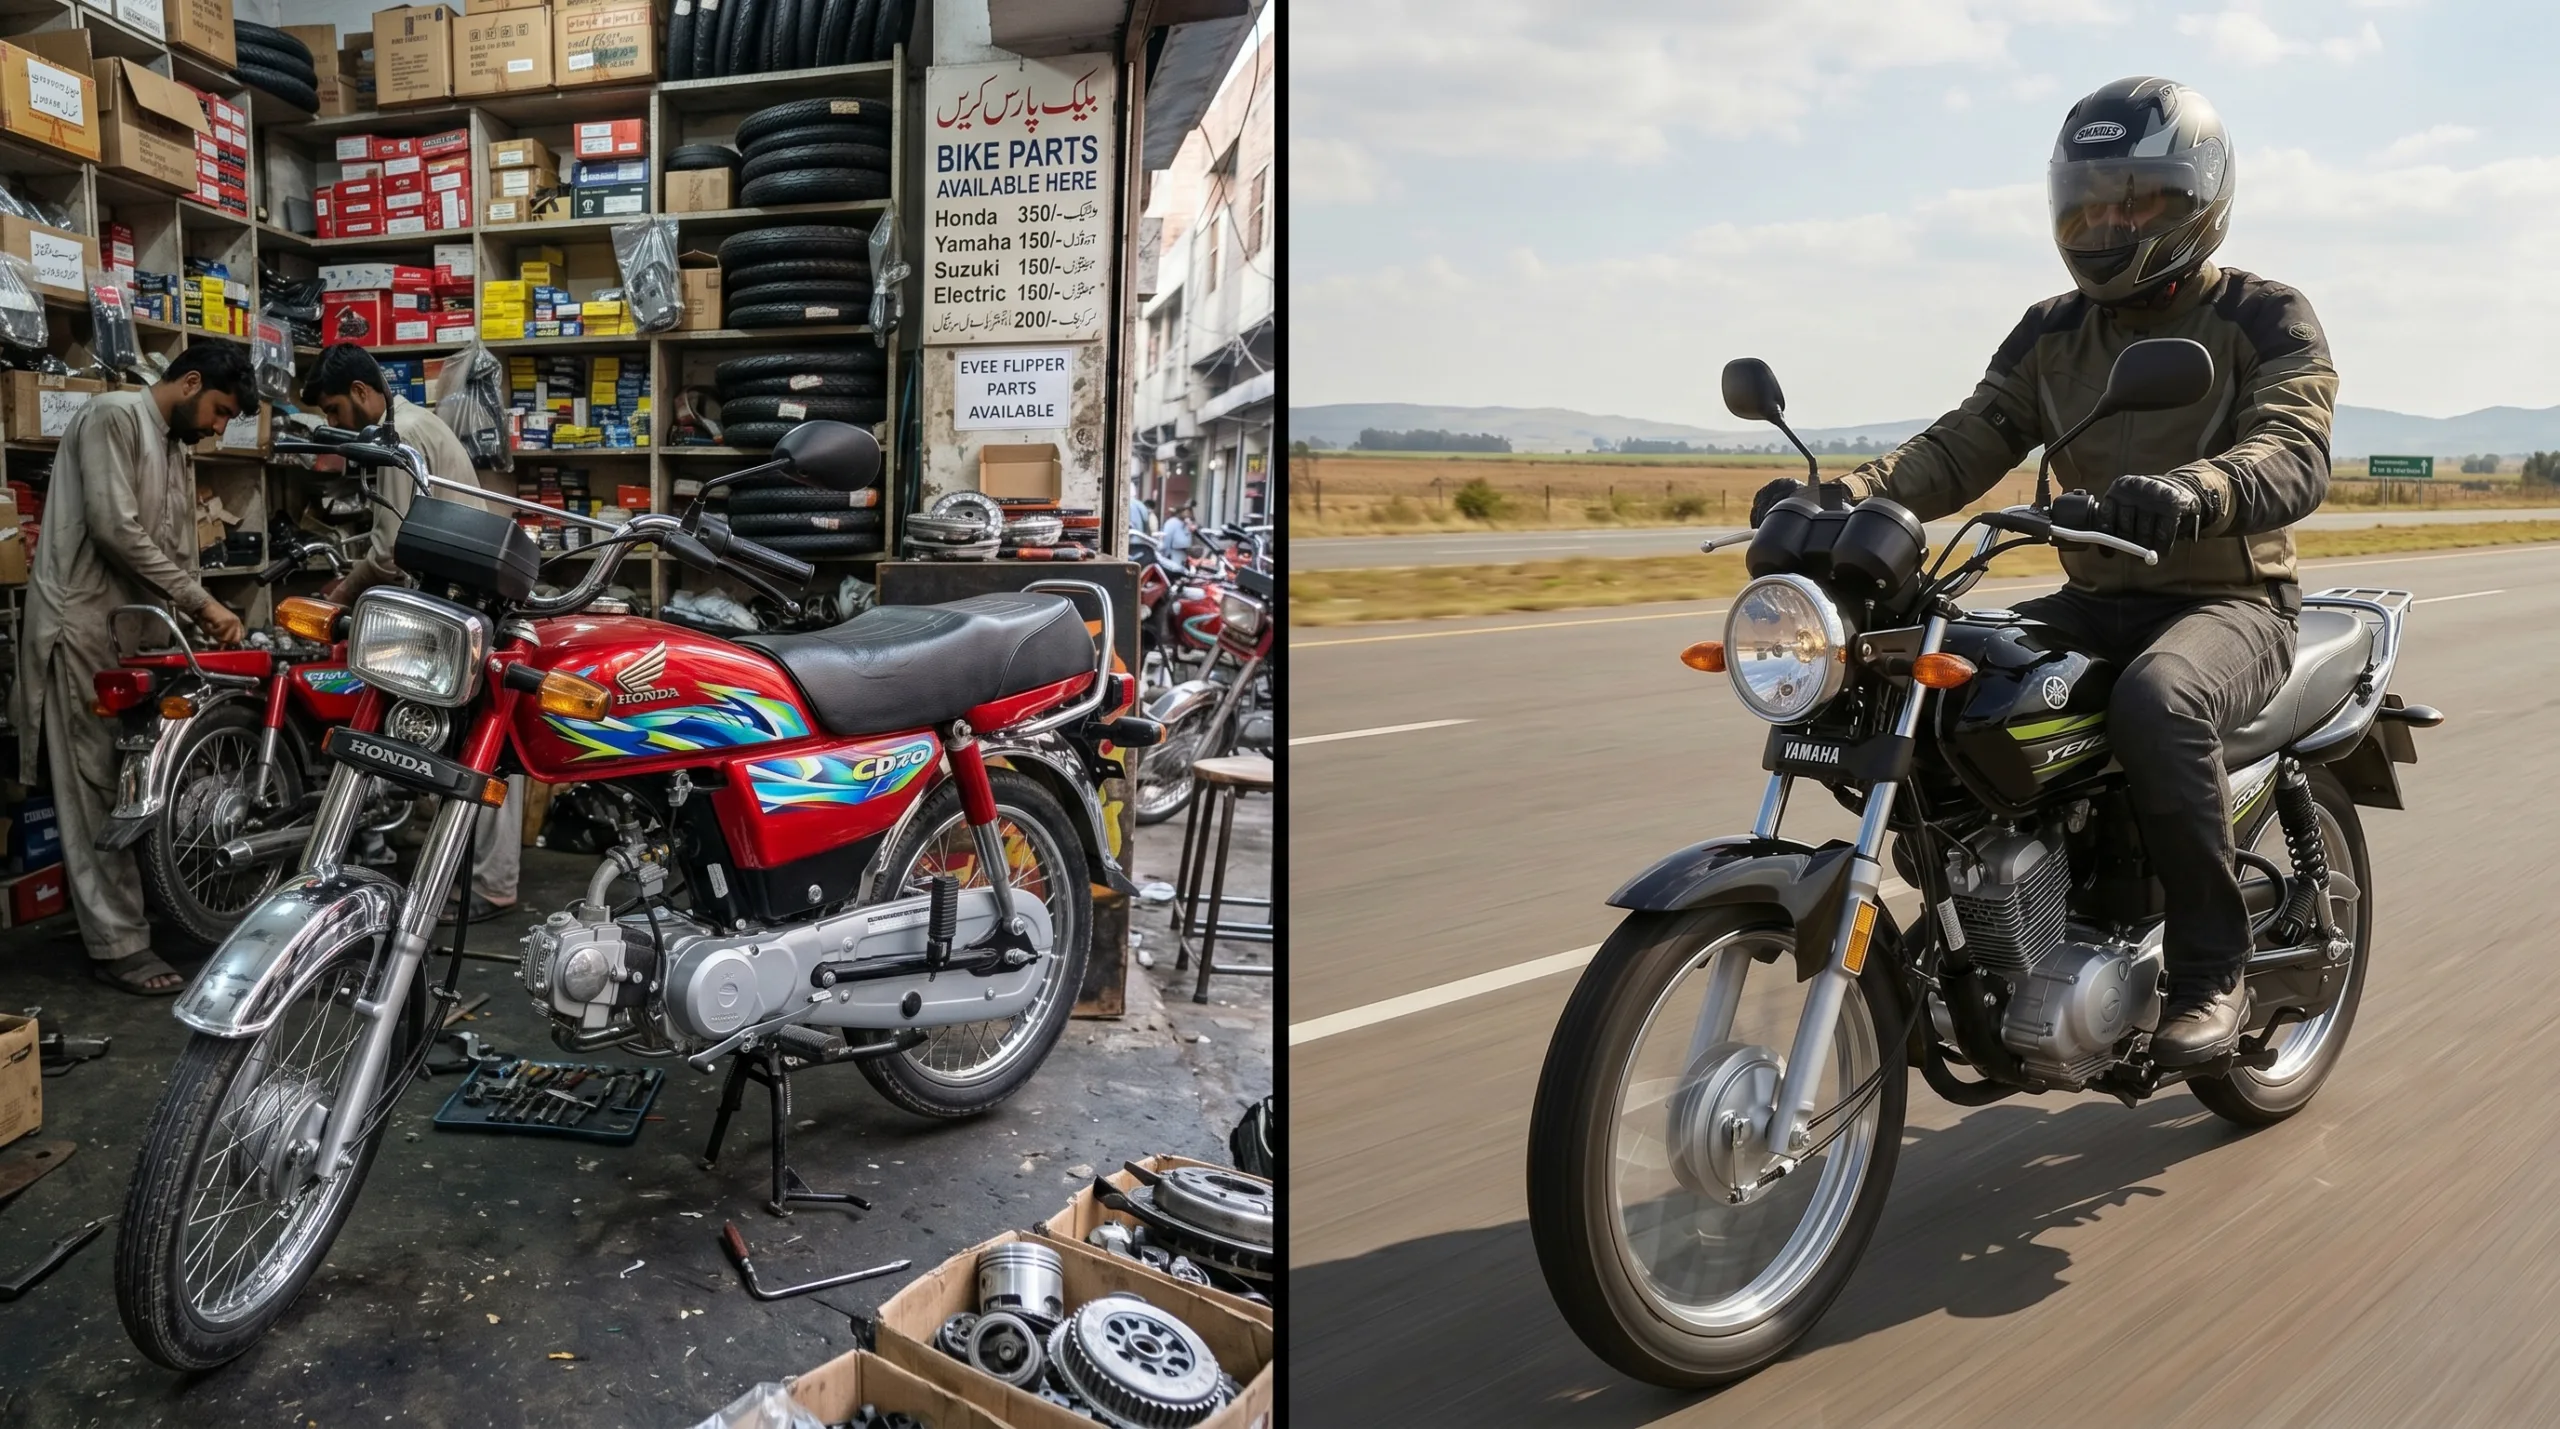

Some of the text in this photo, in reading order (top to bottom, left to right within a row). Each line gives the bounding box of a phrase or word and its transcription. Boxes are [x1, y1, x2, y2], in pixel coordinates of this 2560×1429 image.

[938, 135, 1098, 173] BIKE PARTS
[937, 170, 1097, 198] AVAILABLE HERE
[935, 208, 998, 228] Honda
[1018, 203, 1063, 224] 350/-
[934, 234, 1012, 253] Yamaha
[1018, 230, 1063, 250] 150/-
[934, 259, 1000, 279] Suzuki
[1018, 256, 1062, 276] 150/-
[934, 284, 1006, 304] Electric
[1014, 310, 1058, 329] 200/-
[960, 357, 1066, 375] EVEE FLIPPER
[986, 381, 1037, 397] PARTS
[968, 404, 1055, 420] AVAILABLE
[616, 687, 681, 705] HONDA
[348, 738, 435, 778] HONDA
[1784, 741, 1840, 765] YAMAHA
